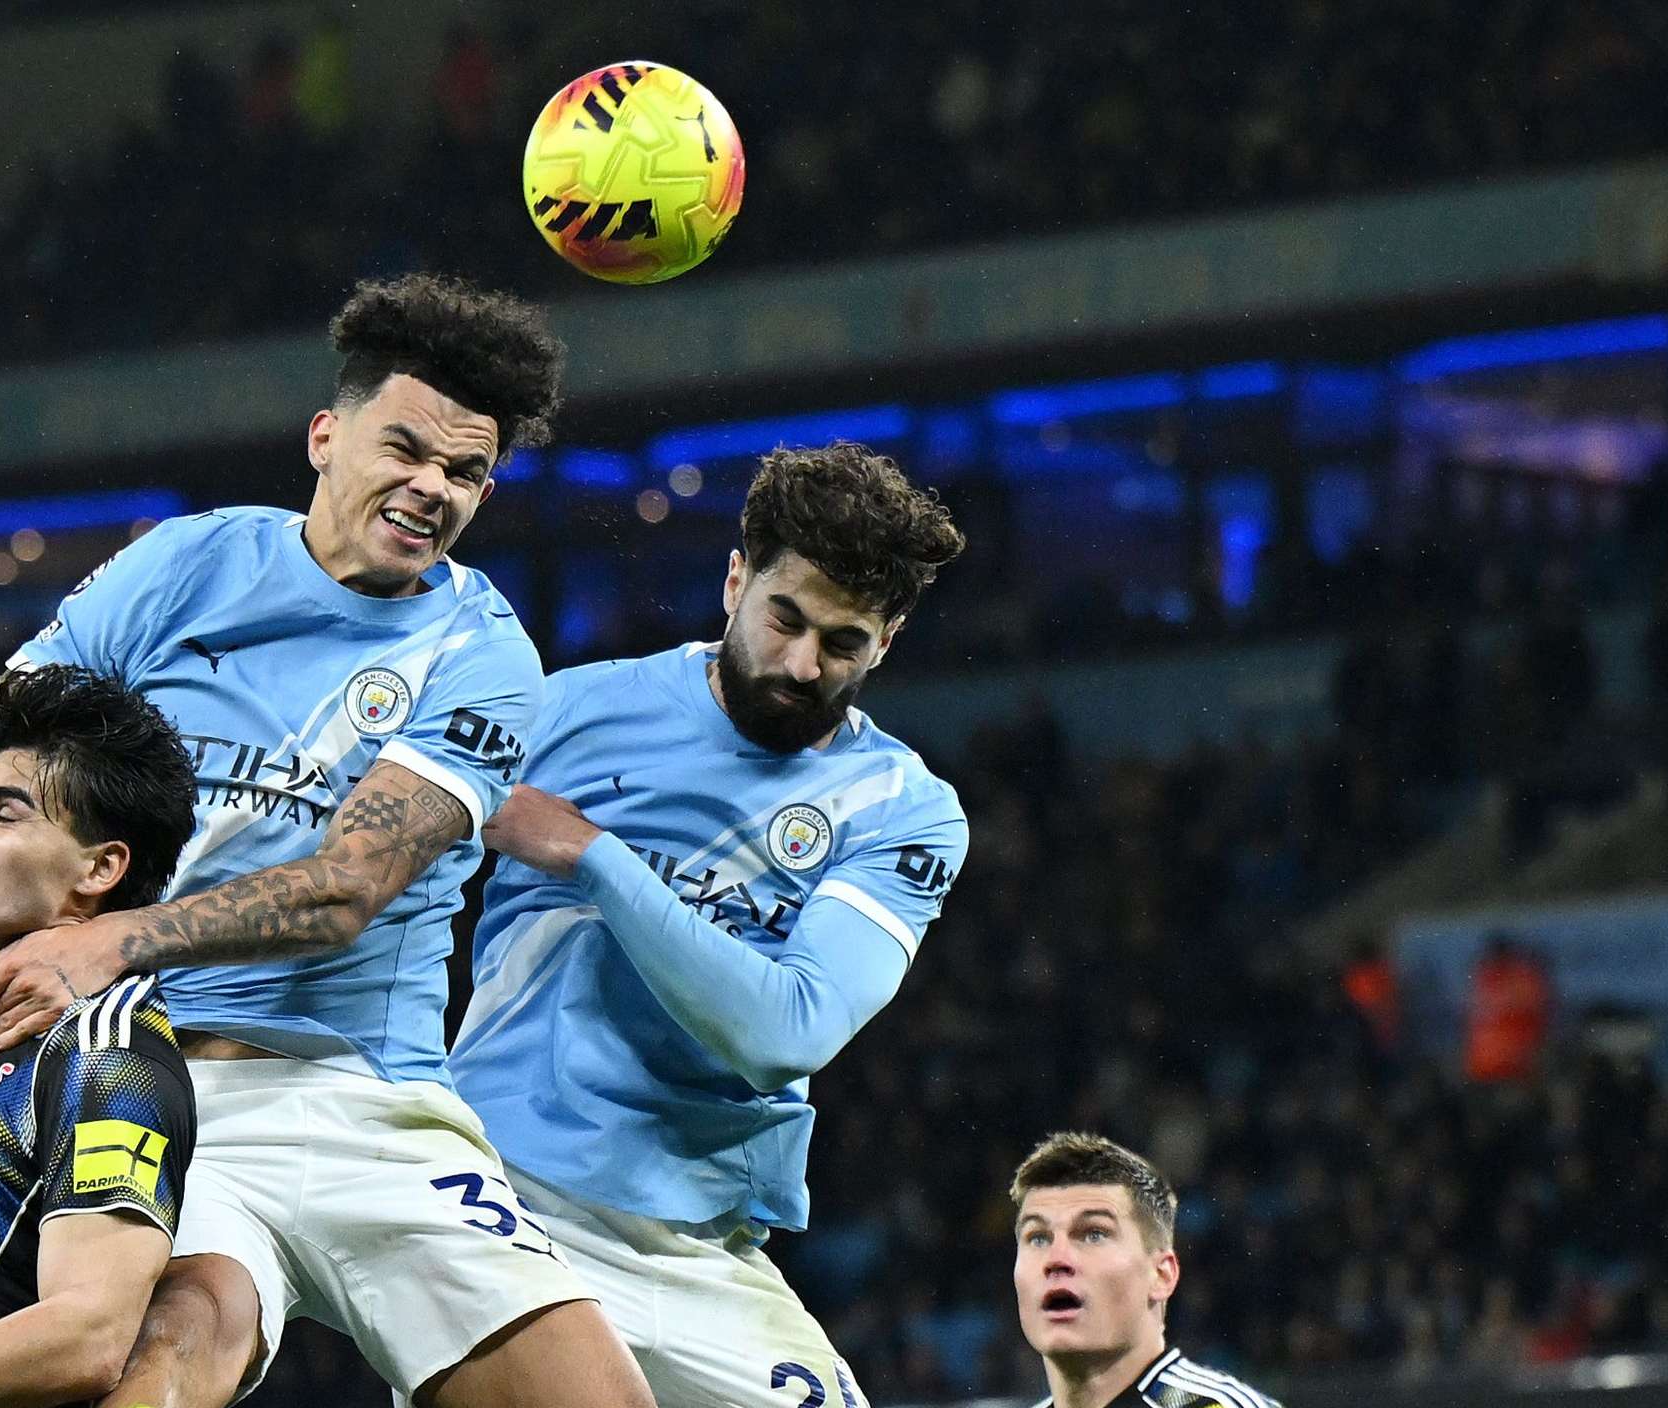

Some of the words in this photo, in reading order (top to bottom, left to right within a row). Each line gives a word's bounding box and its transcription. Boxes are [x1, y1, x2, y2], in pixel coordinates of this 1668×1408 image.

[356, 673, 408, 704] MANCHESTER
[358, 721, 378, 732] CITY
[180, 733, 382, 800] TIHA
[194, 785, 330, 830] IRWAY
[780, 808, 829, 840] MANCHESTER
[780, 855, 799, 867] CITY
[76, 1174, 154, 1200] PARIMATCH
